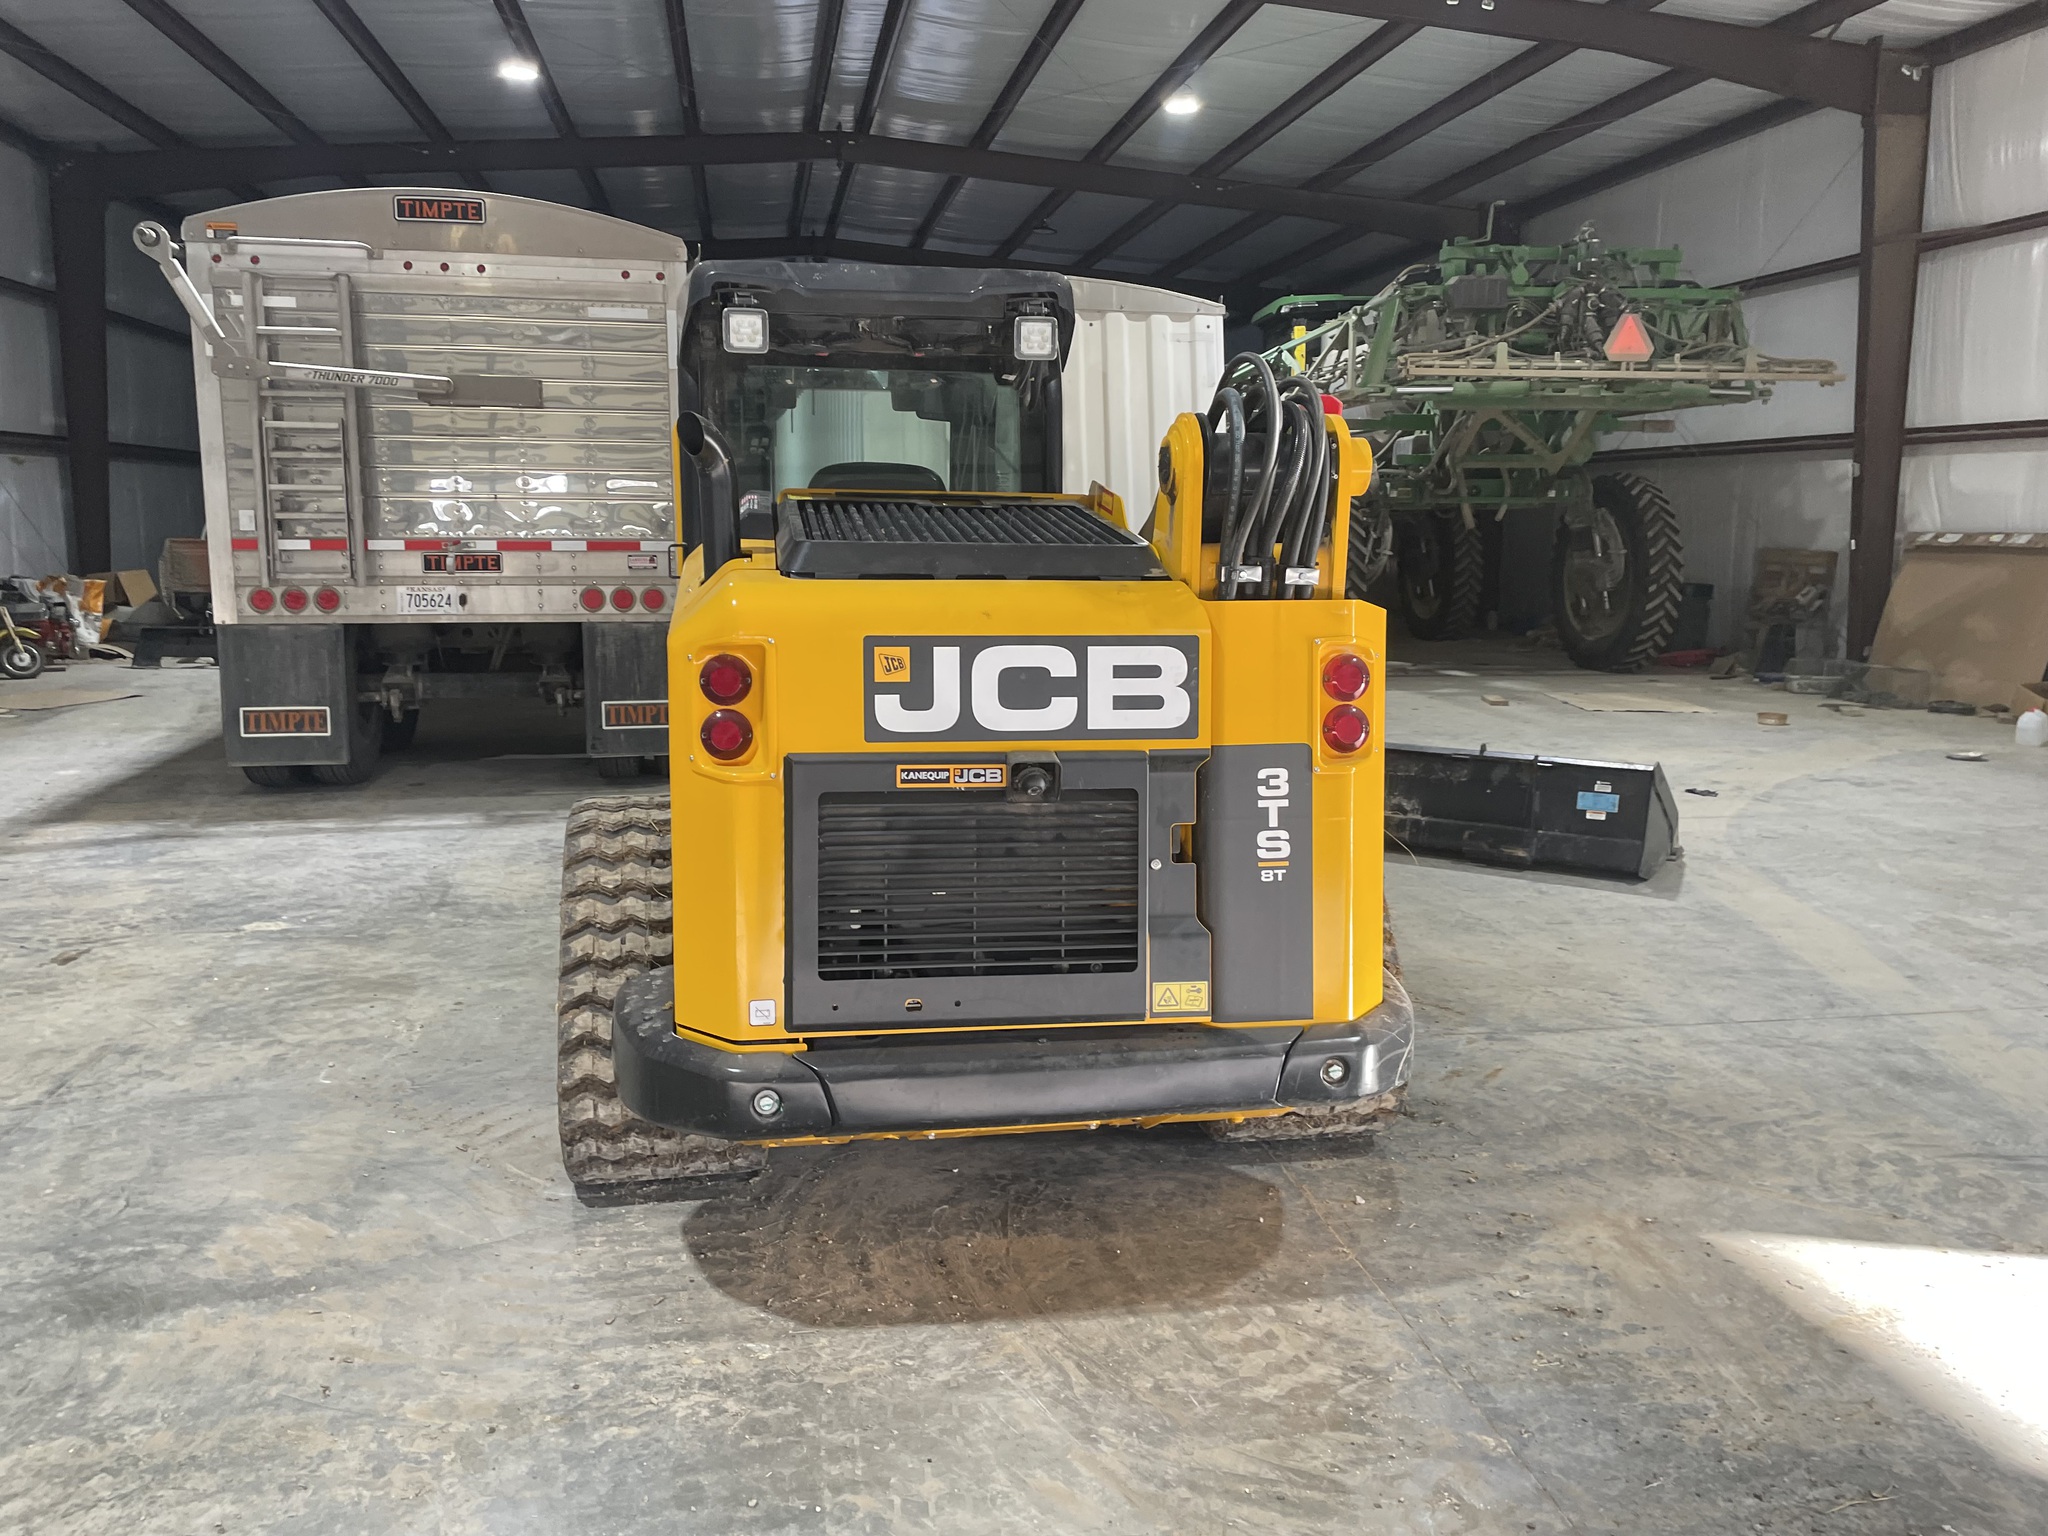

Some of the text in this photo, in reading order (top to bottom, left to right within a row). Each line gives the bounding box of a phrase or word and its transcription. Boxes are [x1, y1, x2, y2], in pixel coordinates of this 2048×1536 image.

[400, 200, 480, 220] TIMPTE
[312, 370, 399, 386] THUNDER 7000
[406, 593, 452, 608] 705624
[883, 656, 904, 673] JCB
[874, 645, 1191, 733] JCB
[244, 711, 327, 732] TIMPTE
[606, 704, 669, 725] TIMPT
[900, 768, 1002, 783] KANEQUIP JCB
[1260, 869, 1287, 882] 8T
